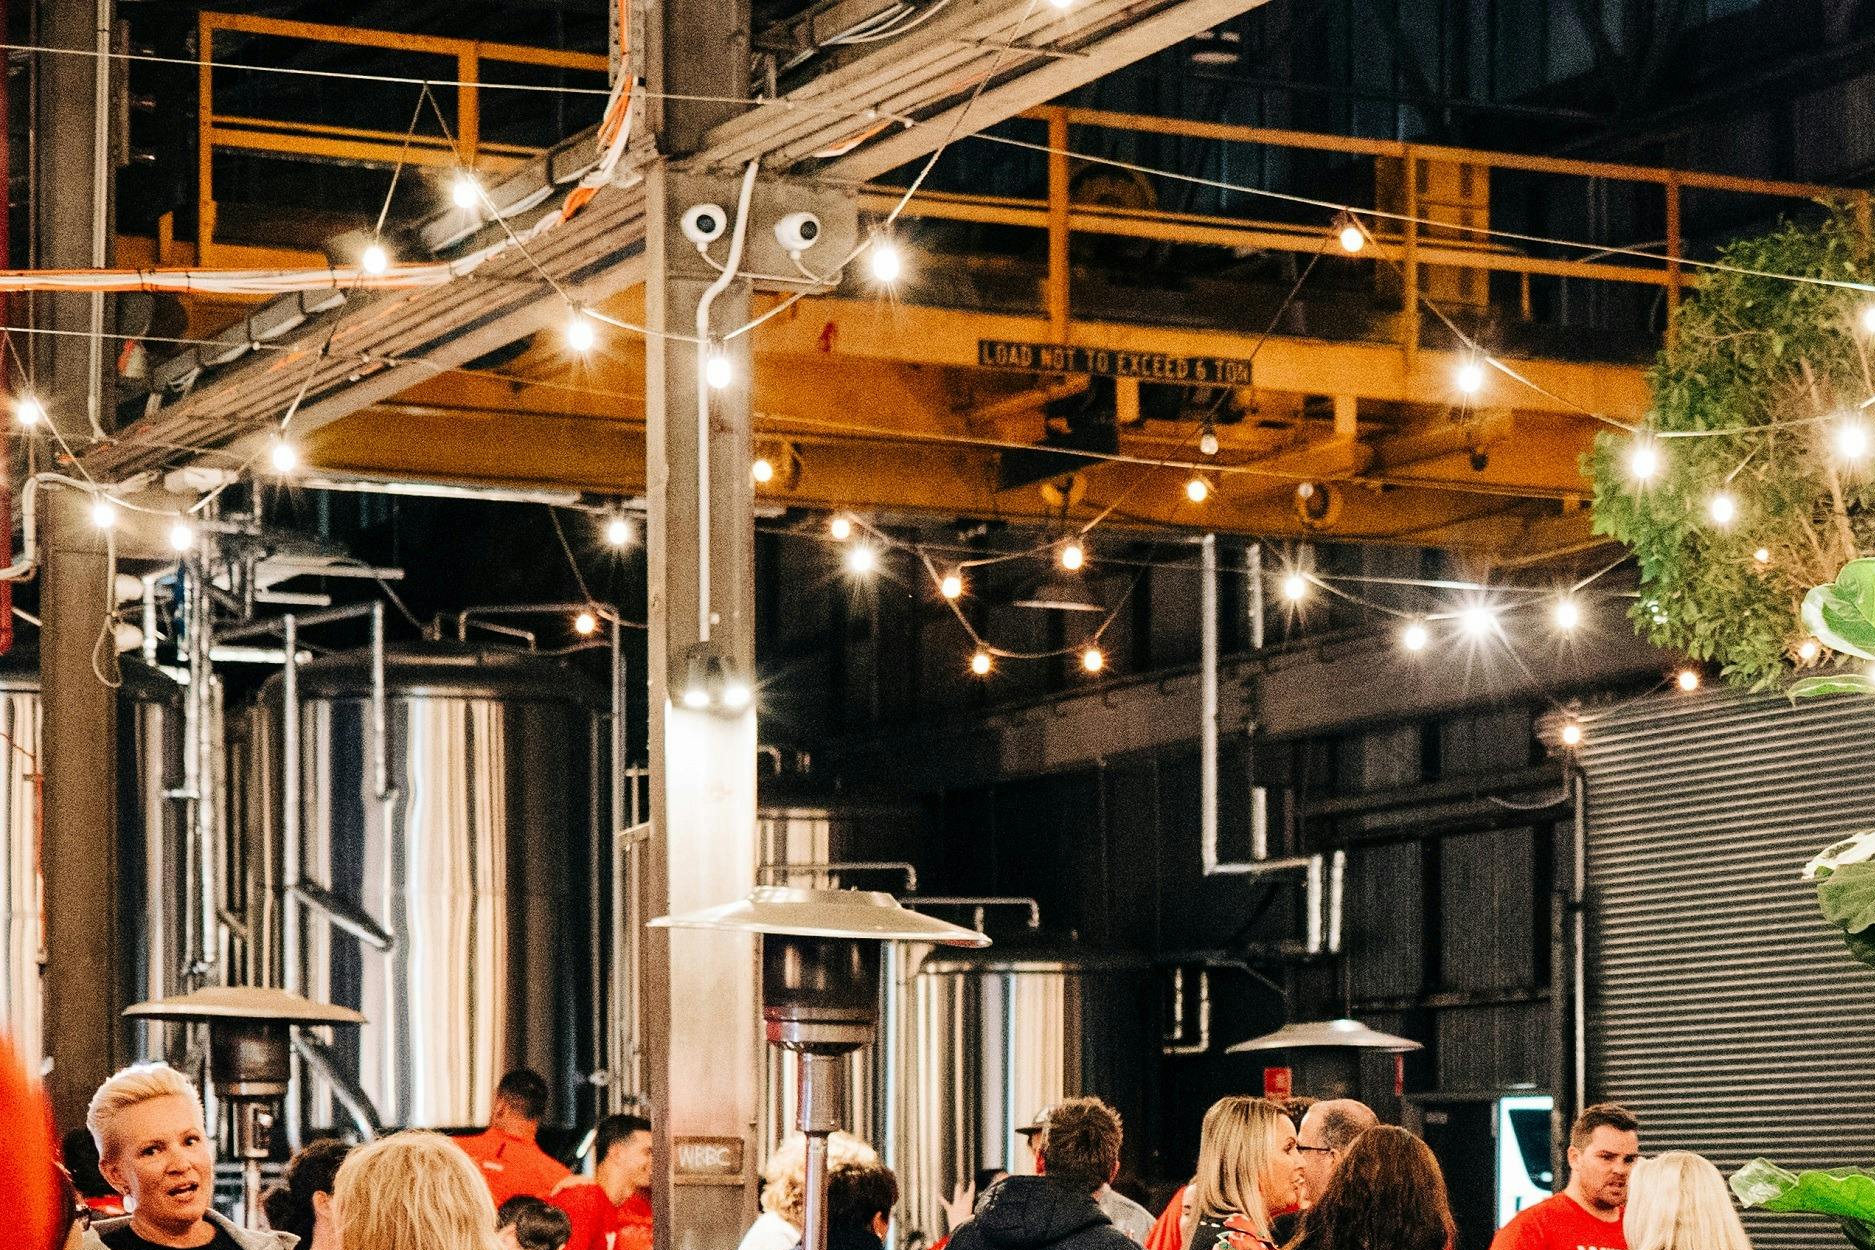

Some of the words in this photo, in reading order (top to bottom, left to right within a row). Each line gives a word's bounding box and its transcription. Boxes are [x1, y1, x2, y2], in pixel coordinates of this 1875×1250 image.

[983, 342, 1033, 368] LOAD
[1085, 349, 1109, 374] TO
[1116, 352, 1189, 380] EXCEED
